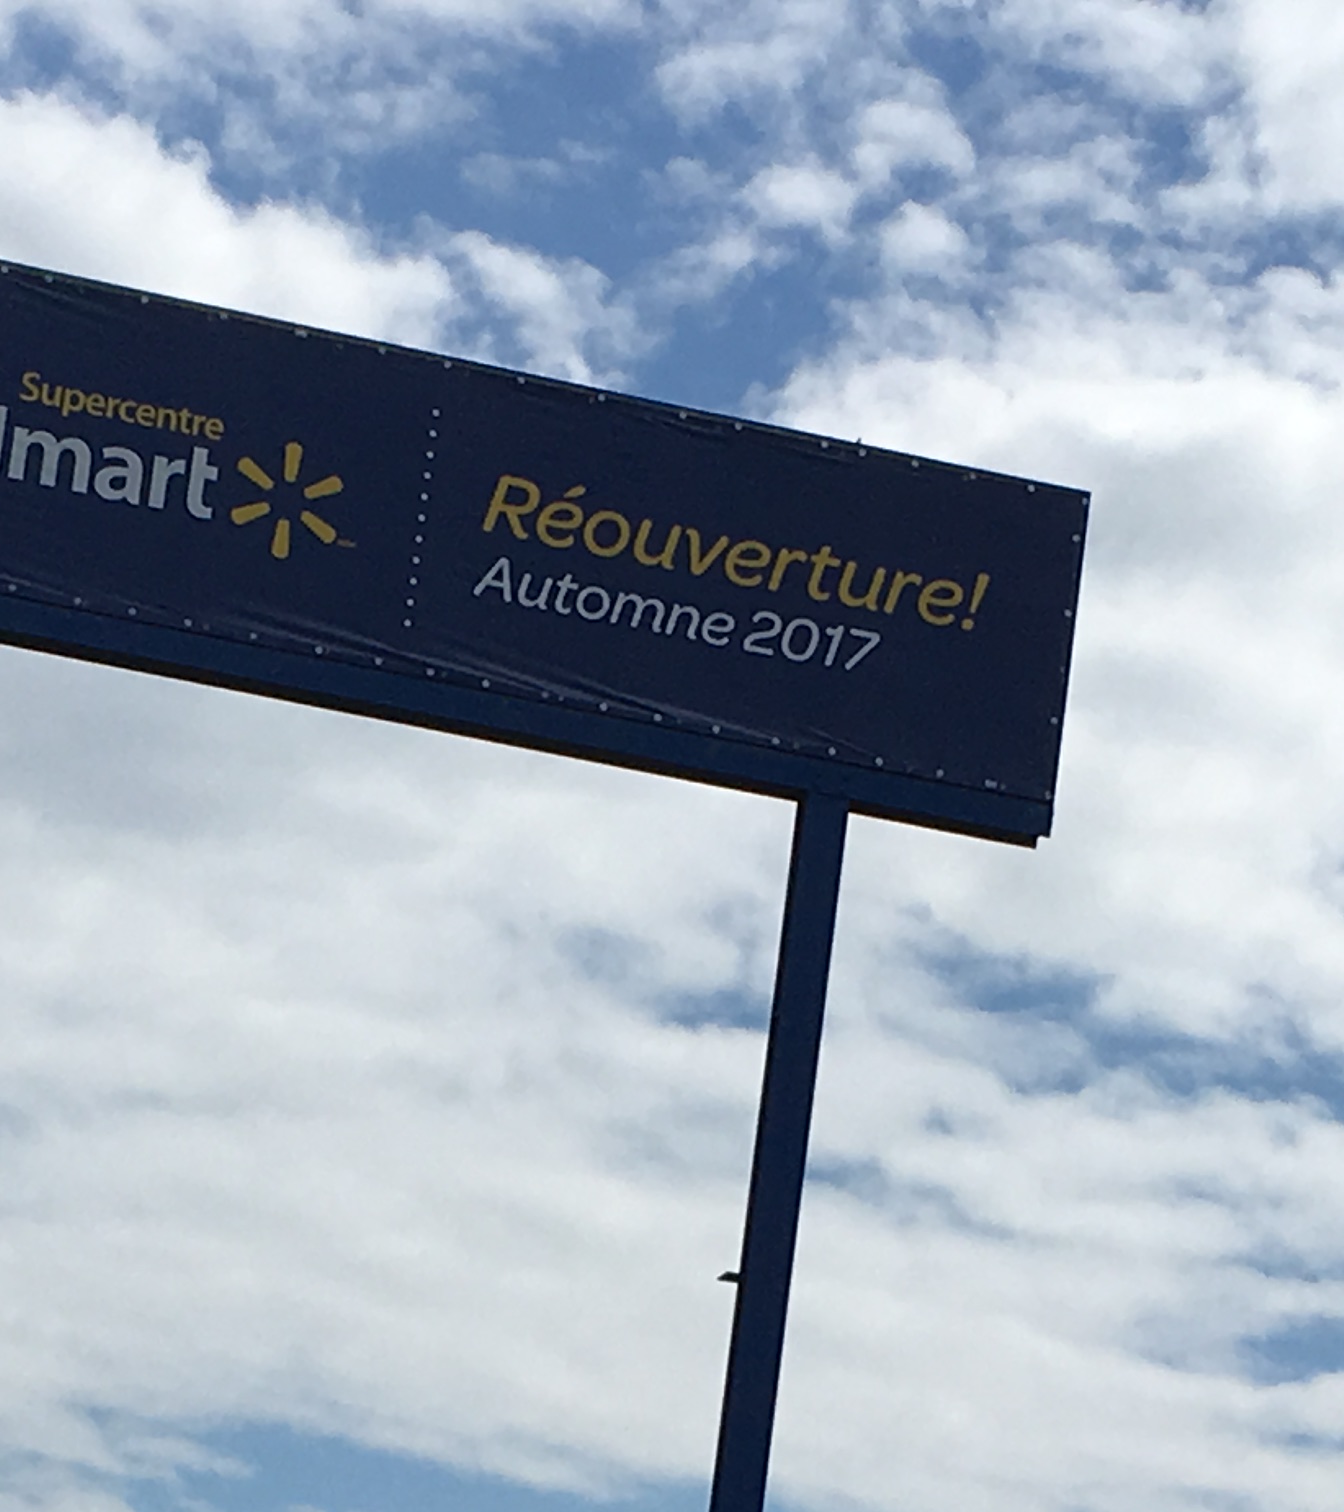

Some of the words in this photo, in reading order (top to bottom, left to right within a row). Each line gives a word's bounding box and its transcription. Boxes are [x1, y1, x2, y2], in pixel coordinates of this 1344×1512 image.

[19, 371, 225, 441] Supercentre
[482, 474, 990, 631] Réouverture!
[472, 557, 736, 646] Automne
[743, 611, 881, 671] 2017
